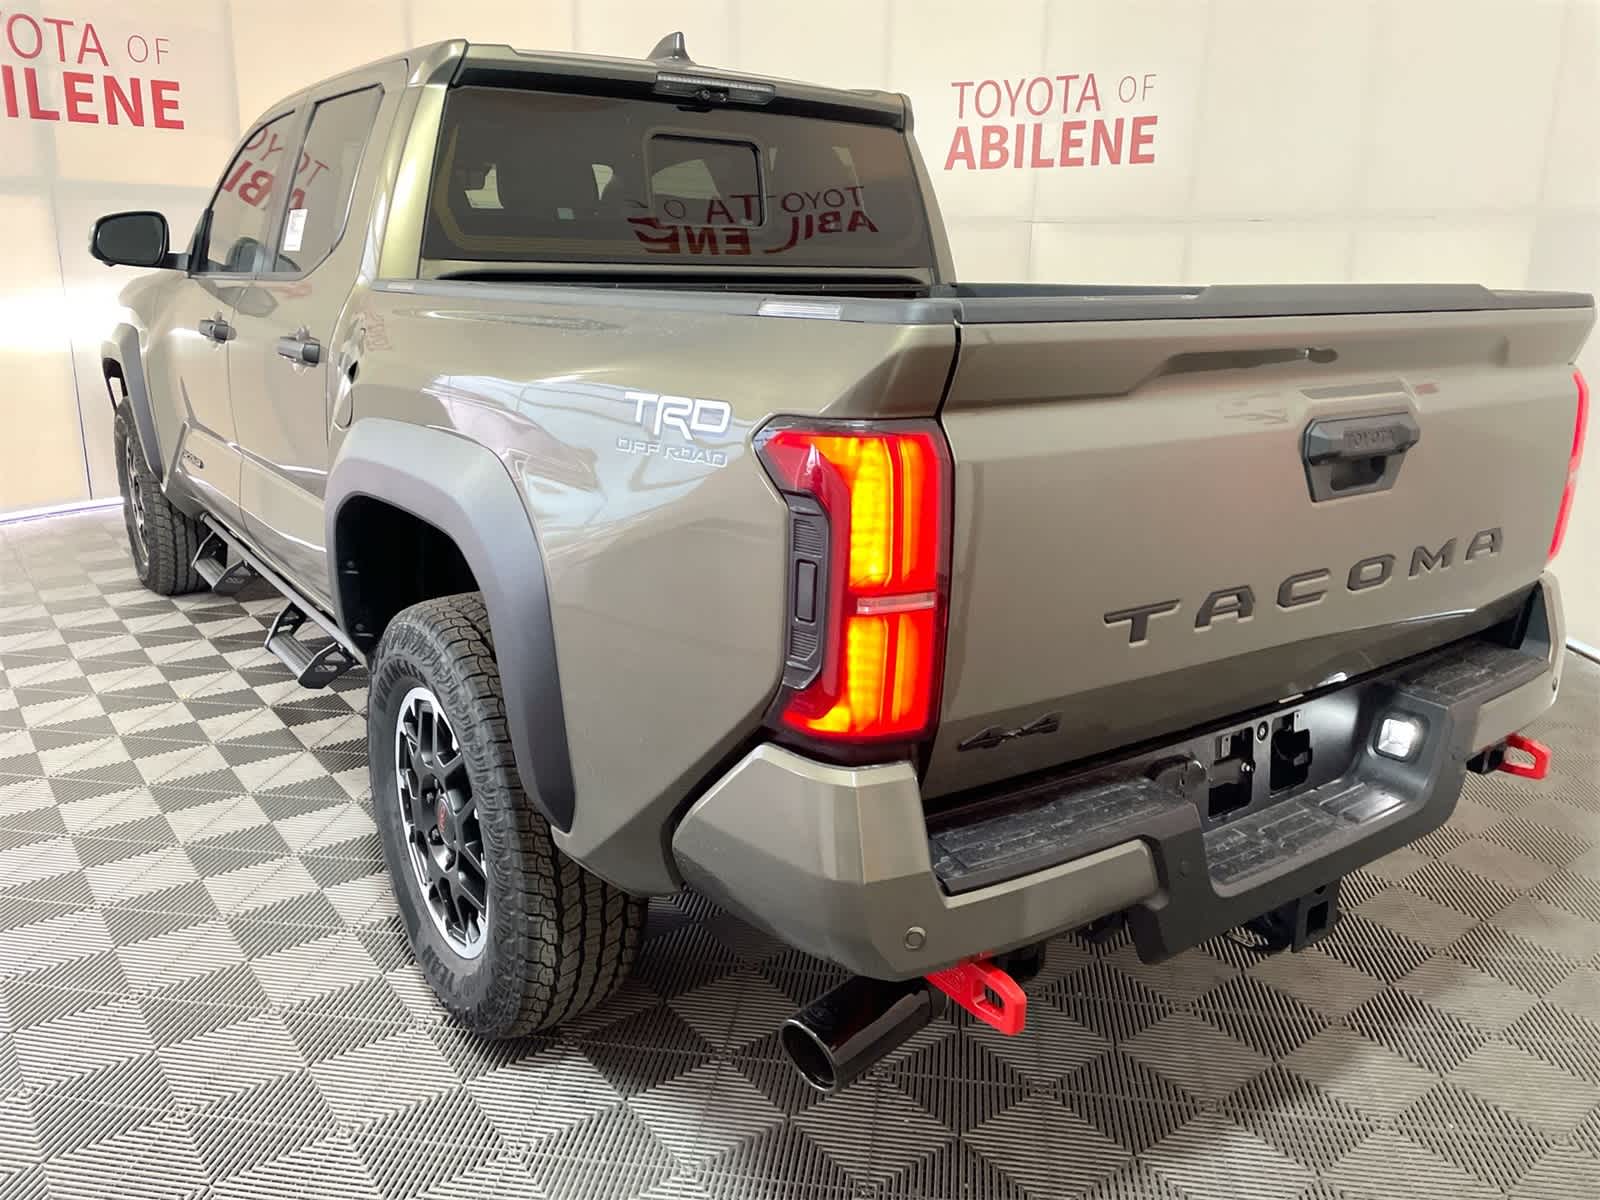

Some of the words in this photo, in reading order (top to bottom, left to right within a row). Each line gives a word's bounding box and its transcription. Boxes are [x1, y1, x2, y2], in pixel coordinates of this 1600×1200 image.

[0, 11, 109, 66] OTA
[127, 35, 169, 64] OF
[1, 64, 185, 130] ILENE
[951, 73, 1101, 119] TOYOTA
[1118, 74, 1157, 103] OF
[944, 115, 1158, 170] ABILENE
[624, 391, 732, 441] TRD
[615, 437, 661, 456] OFF
[664, 447, 728, 468] ROAD
[1103, 527, 1503, 648] TACOMA
